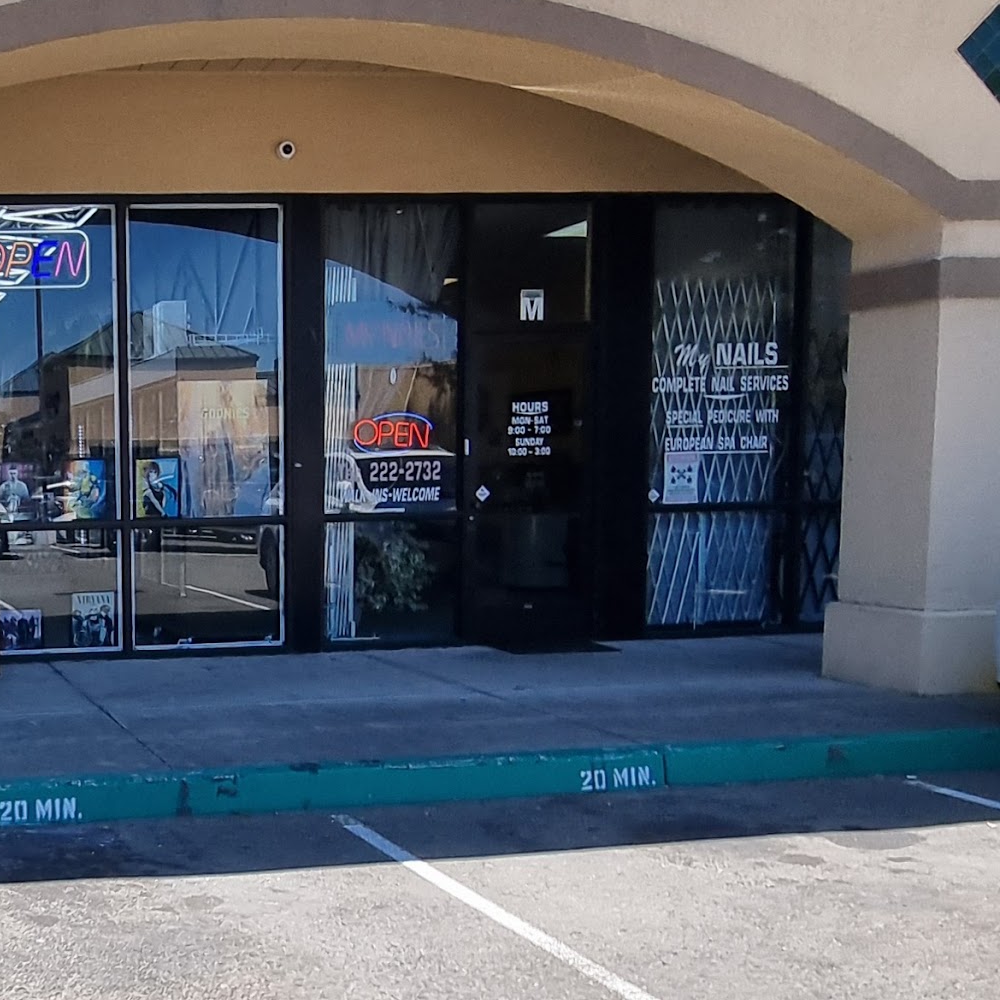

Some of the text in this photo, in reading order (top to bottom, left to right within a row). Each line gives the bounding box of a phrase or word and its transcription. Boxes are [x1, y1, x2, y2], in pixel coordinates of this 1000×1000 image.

[520, 289, 544, 321] M
[715, 341, 779, 366] NAILS
[651, 374, 789, 393] COMPLETE NAIL SERVICES
[511, 401, 549, 413] HOURS
[666, 408, 780, 424] SPECIAL PEDICURE WITH
[354, 419, 430, 448] OPEN
[515, 437, 544, 447] SUNDAY
[664, 435, 768, 451] EUROPEAN SPA CHAIR
[369, 460, 441, 482] 222-2732
[75, 594, 111, 605] NIRVANA
[580, 765, 656, 791] 20 MIN.
[0, 797, 82, 821] 20 MIN.
